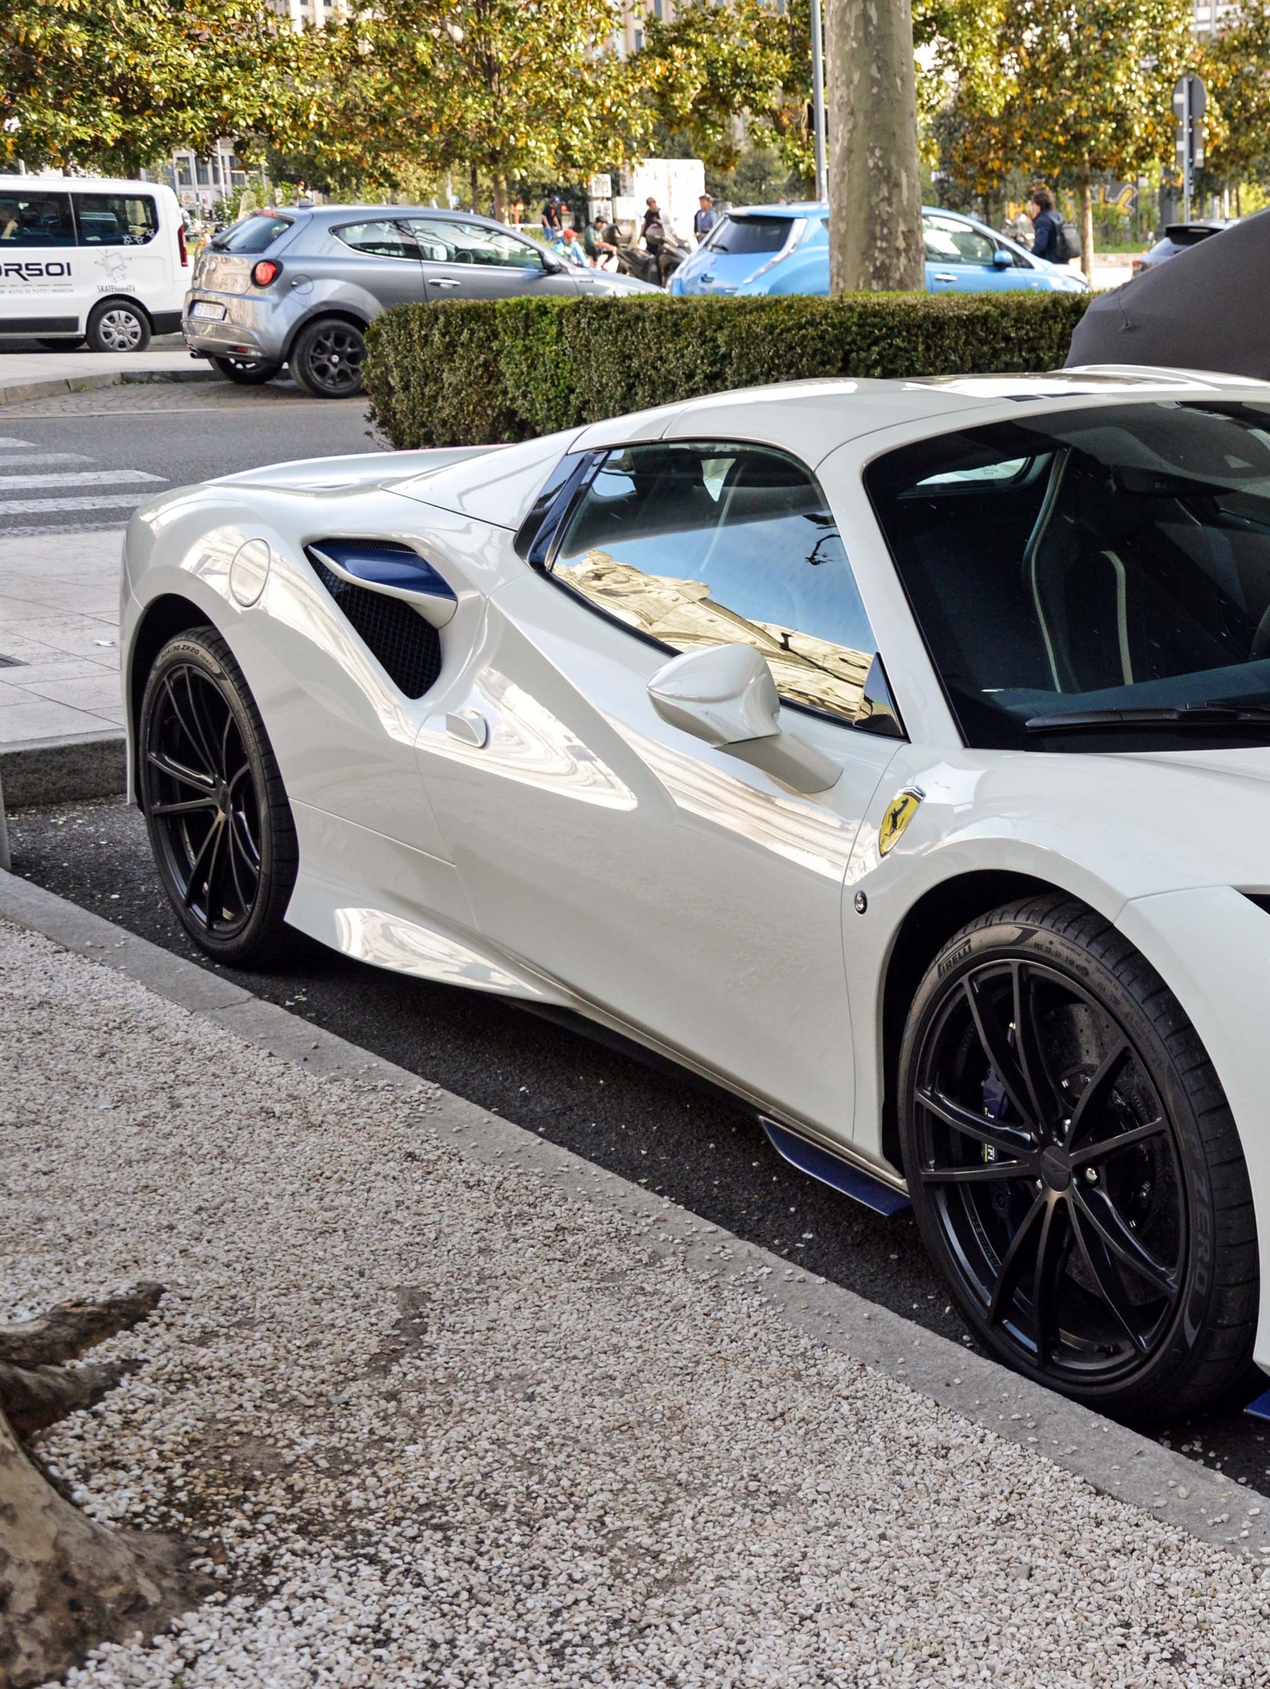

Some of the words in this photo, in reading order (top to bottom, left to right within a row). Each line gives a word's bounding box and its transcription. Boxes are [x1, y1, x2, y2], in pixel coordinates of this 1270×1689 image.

[0, 262, 72, 281] RSOI
[937, 938, 972, 979] PIRELLI
[1191, 1170, 1211, 1297] ZERO
